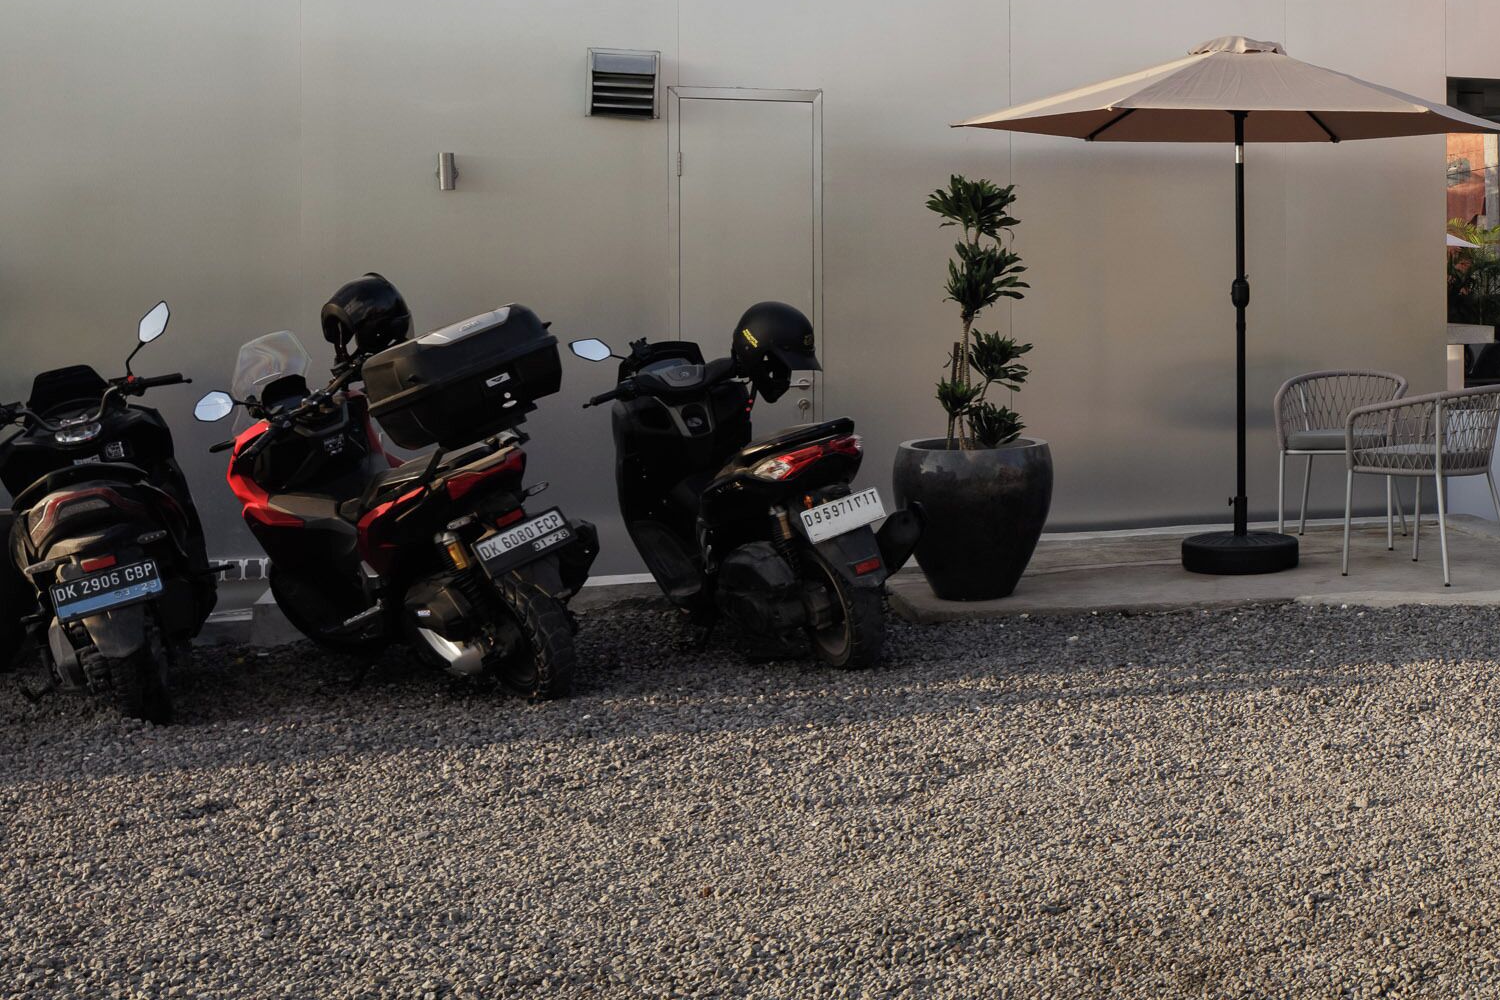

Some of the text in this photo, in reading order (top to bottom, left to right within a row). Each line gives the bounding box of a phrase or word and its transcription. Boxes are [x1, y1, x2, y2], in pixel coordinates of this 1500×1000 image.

[479, 514, 559, 559] DK 6080 FCP
[55, 562, 153, 602] DK 2906 GBP
